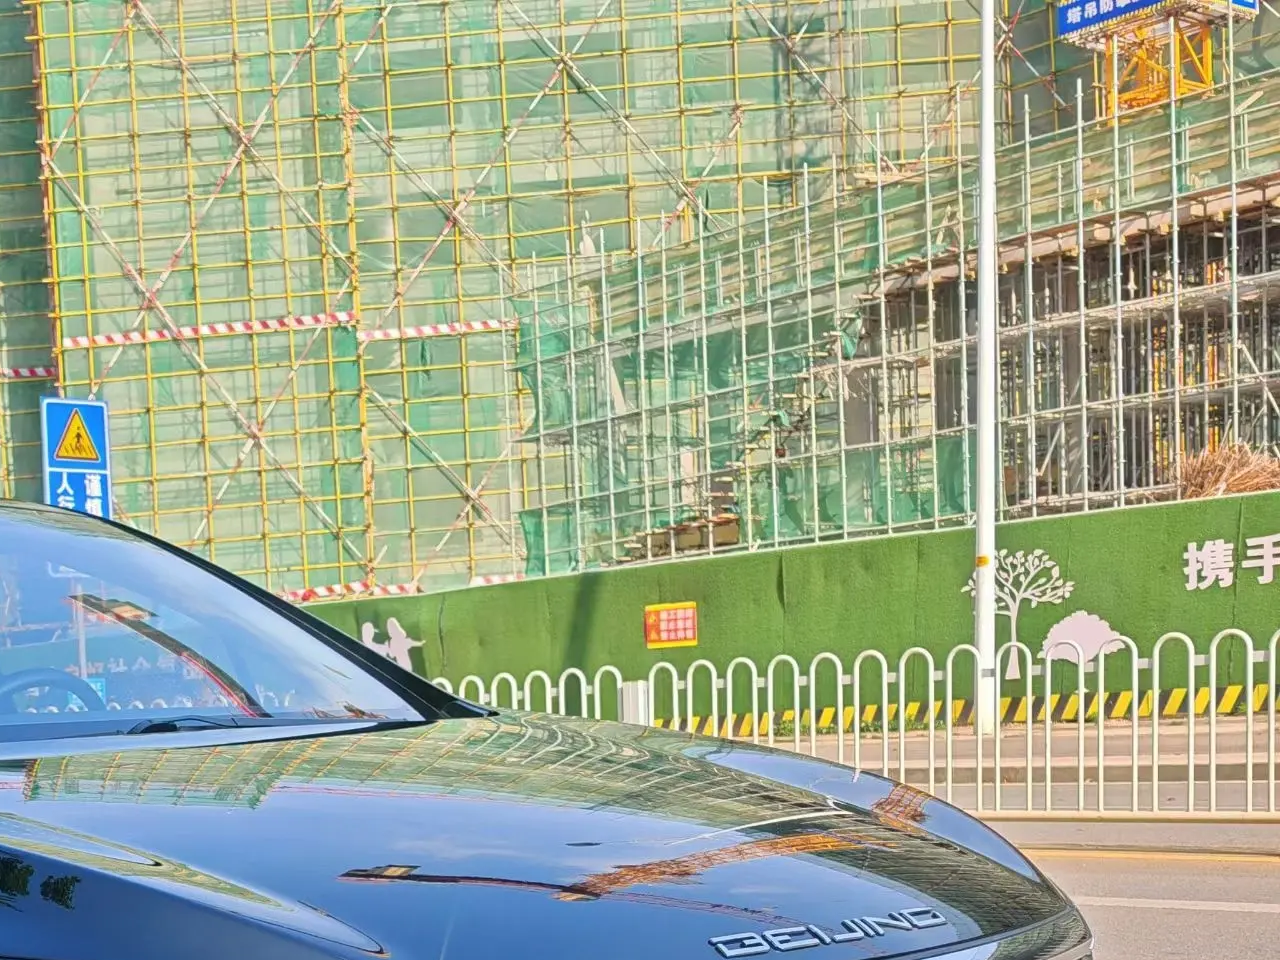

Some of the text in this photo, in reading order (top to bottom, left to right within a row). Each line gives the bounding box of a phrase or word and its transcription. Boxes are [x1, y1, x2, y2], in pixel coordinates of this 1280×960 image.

[1067, 0, 1139, 24] 塔吊防
[1183, 533, 1280, 591] 携手
[709, 907, 948, 958] BEIJING
